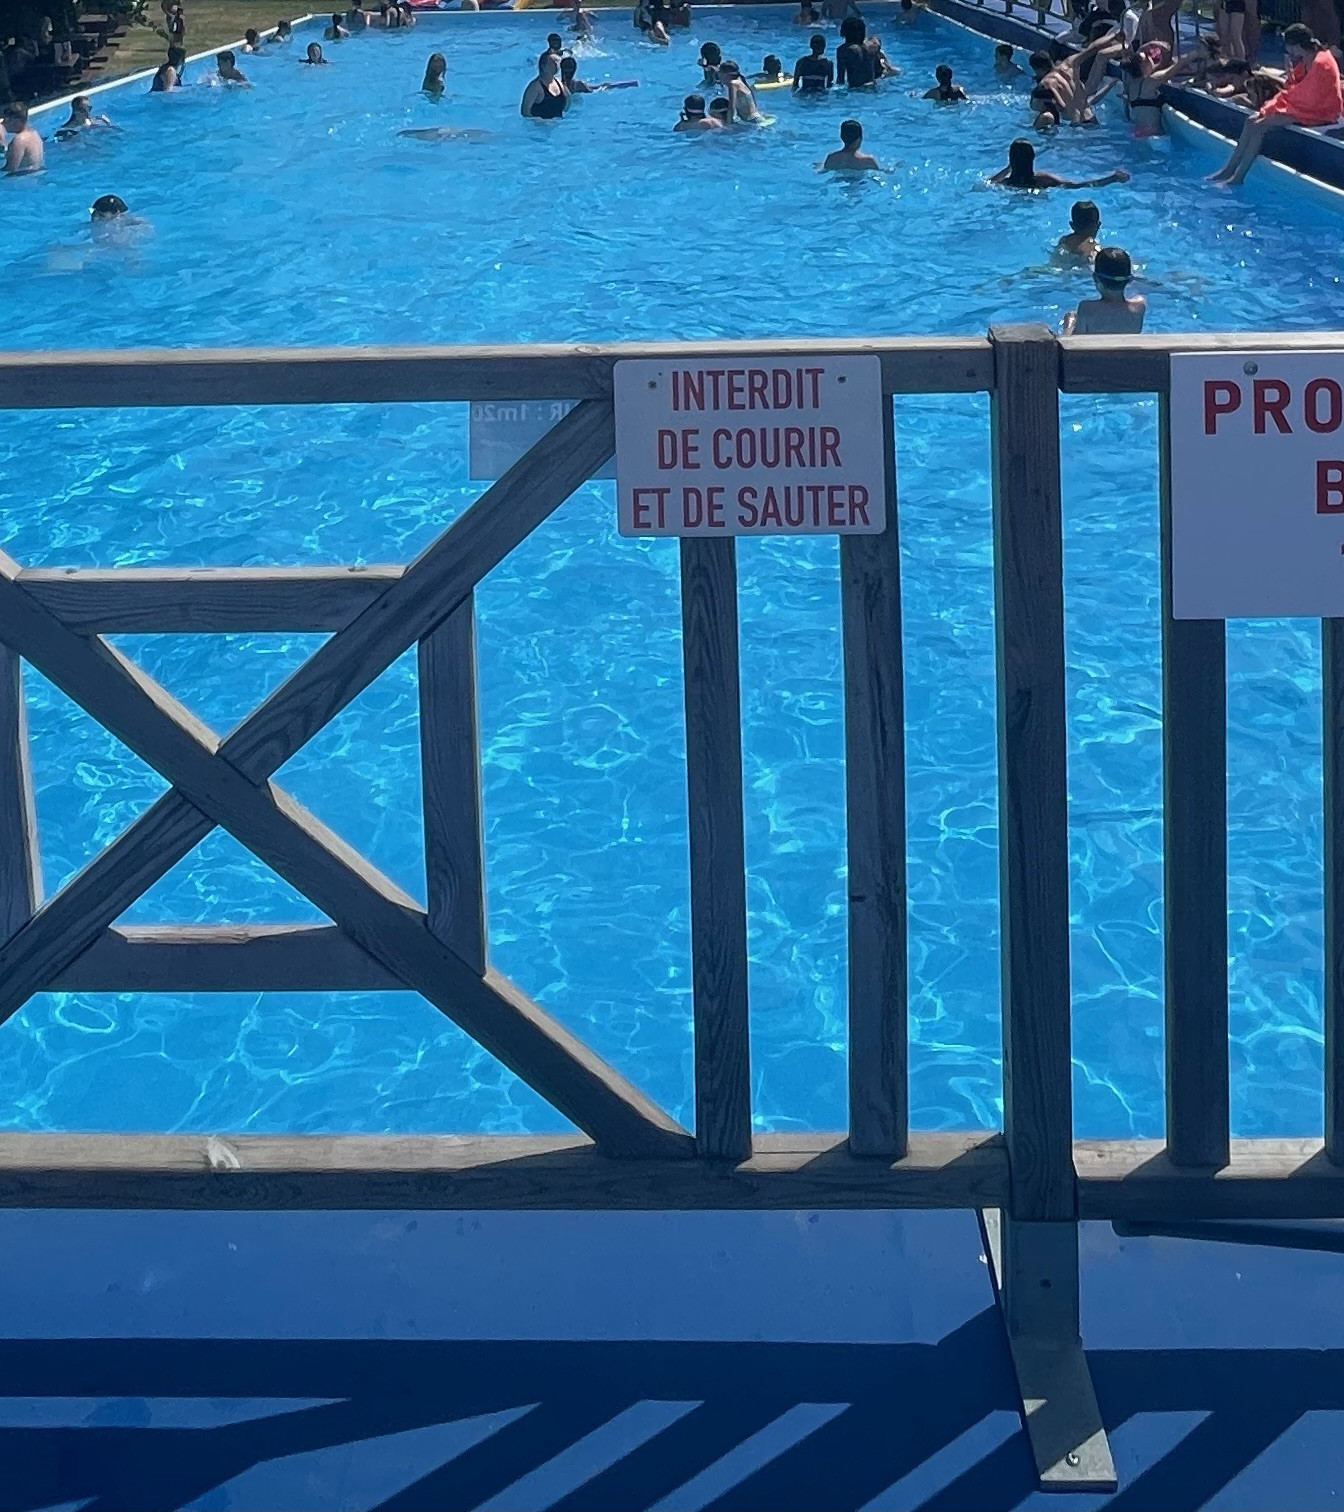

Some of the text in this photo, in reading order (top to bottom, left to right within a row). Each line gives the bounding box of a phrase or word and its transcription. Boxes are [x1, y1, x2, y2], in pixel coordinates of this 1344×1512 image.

[671, 368, 824, 412] INTERDIT
[658, 427, 842, 469] DE COURIR
[632, 485, 870, 529] ET DE SAUTER
